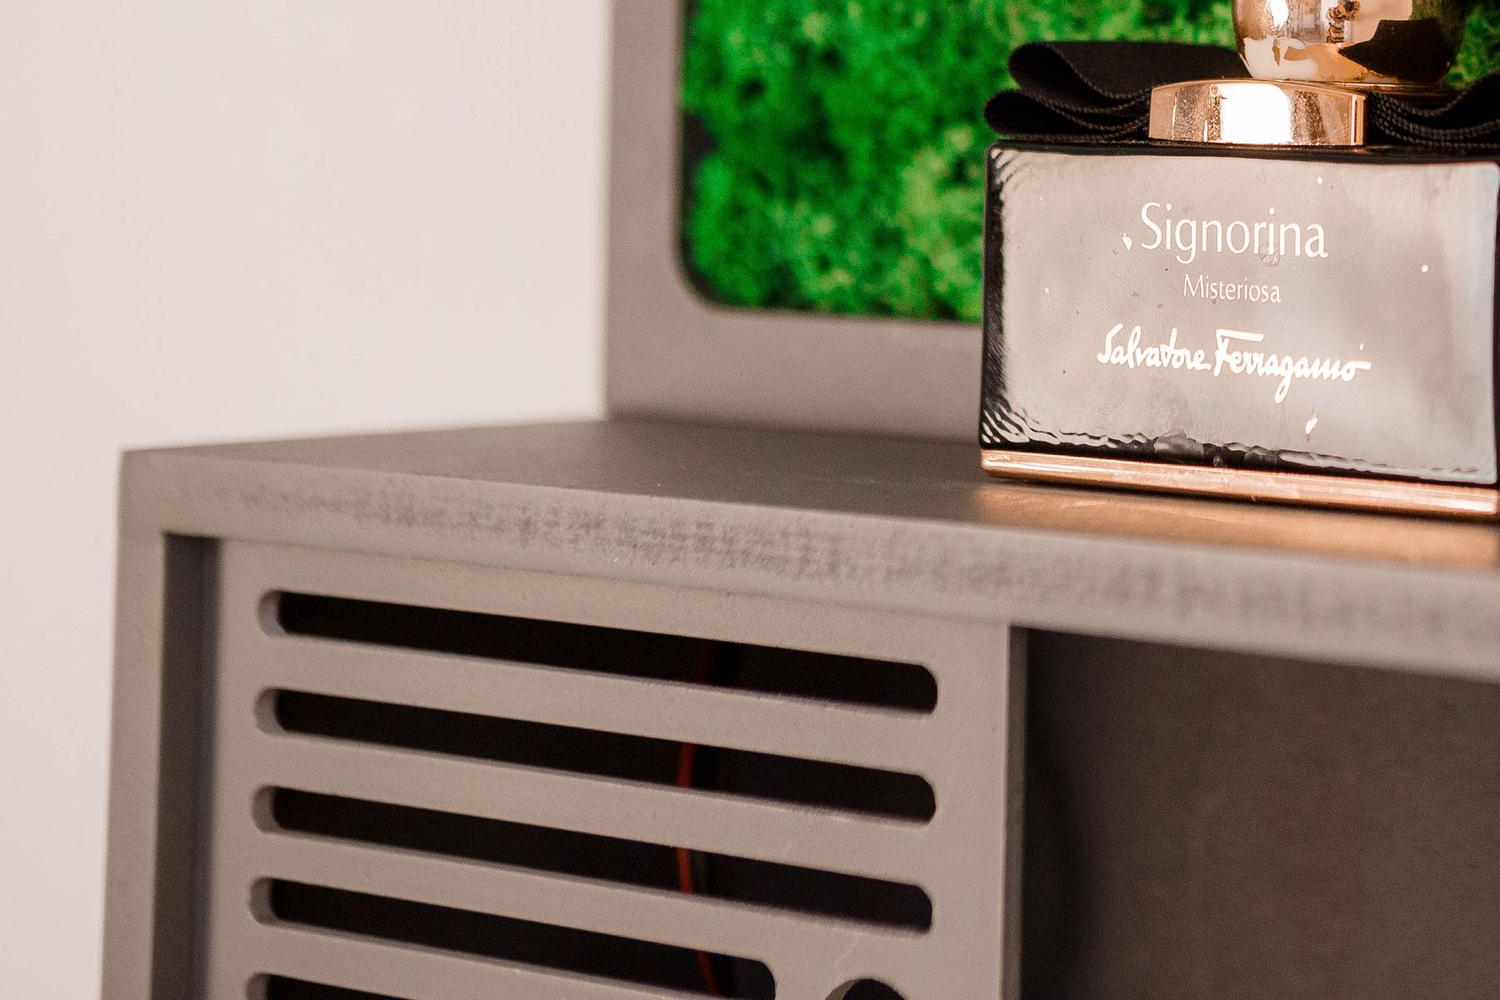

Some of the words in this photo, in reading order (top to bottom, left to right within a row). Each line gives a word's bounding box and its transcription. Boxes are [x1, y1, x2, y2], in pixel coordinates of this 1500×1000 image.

[1139, 200, 1329, 264] Signorina
[1182, 273, 1282, 304] Misteriosa
[1098, 323, 1211, 372] Salvatore
[1212, 329, 1372, 404] Ferragamo
